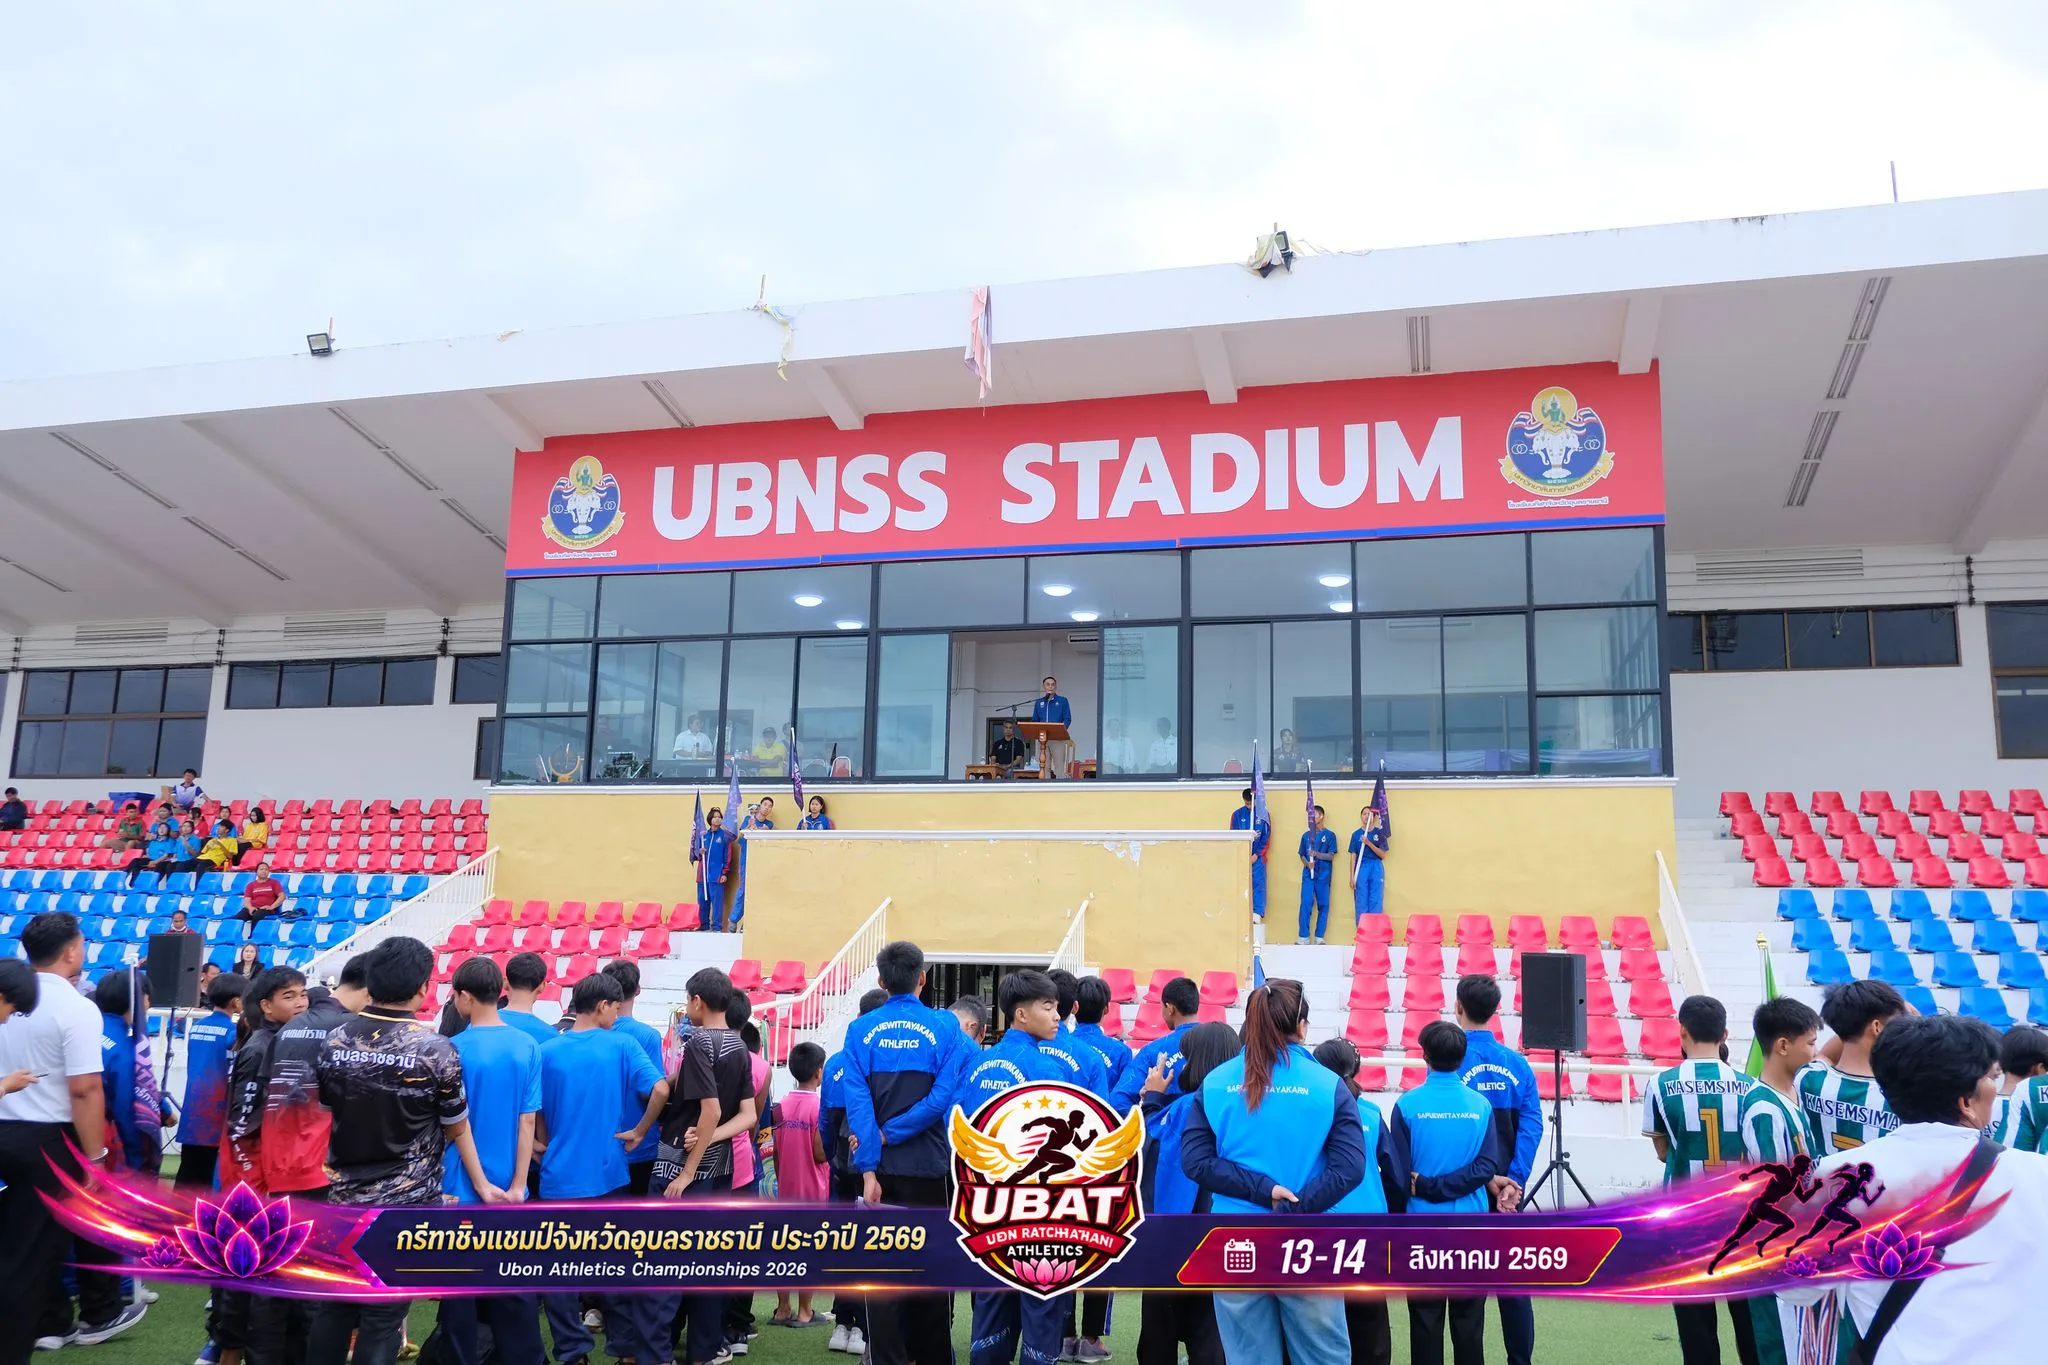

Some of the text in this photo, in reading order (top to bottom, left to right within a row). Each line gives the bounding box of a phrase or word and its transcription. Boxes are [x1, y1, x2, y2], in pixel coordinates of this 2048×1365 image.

[652, 416, 1464, 541] UBNSS STADIUM
[879, 1038, 920, 1049] ATHLETICS
[332, 1049, 417, 1069] อุบลราชธานี
